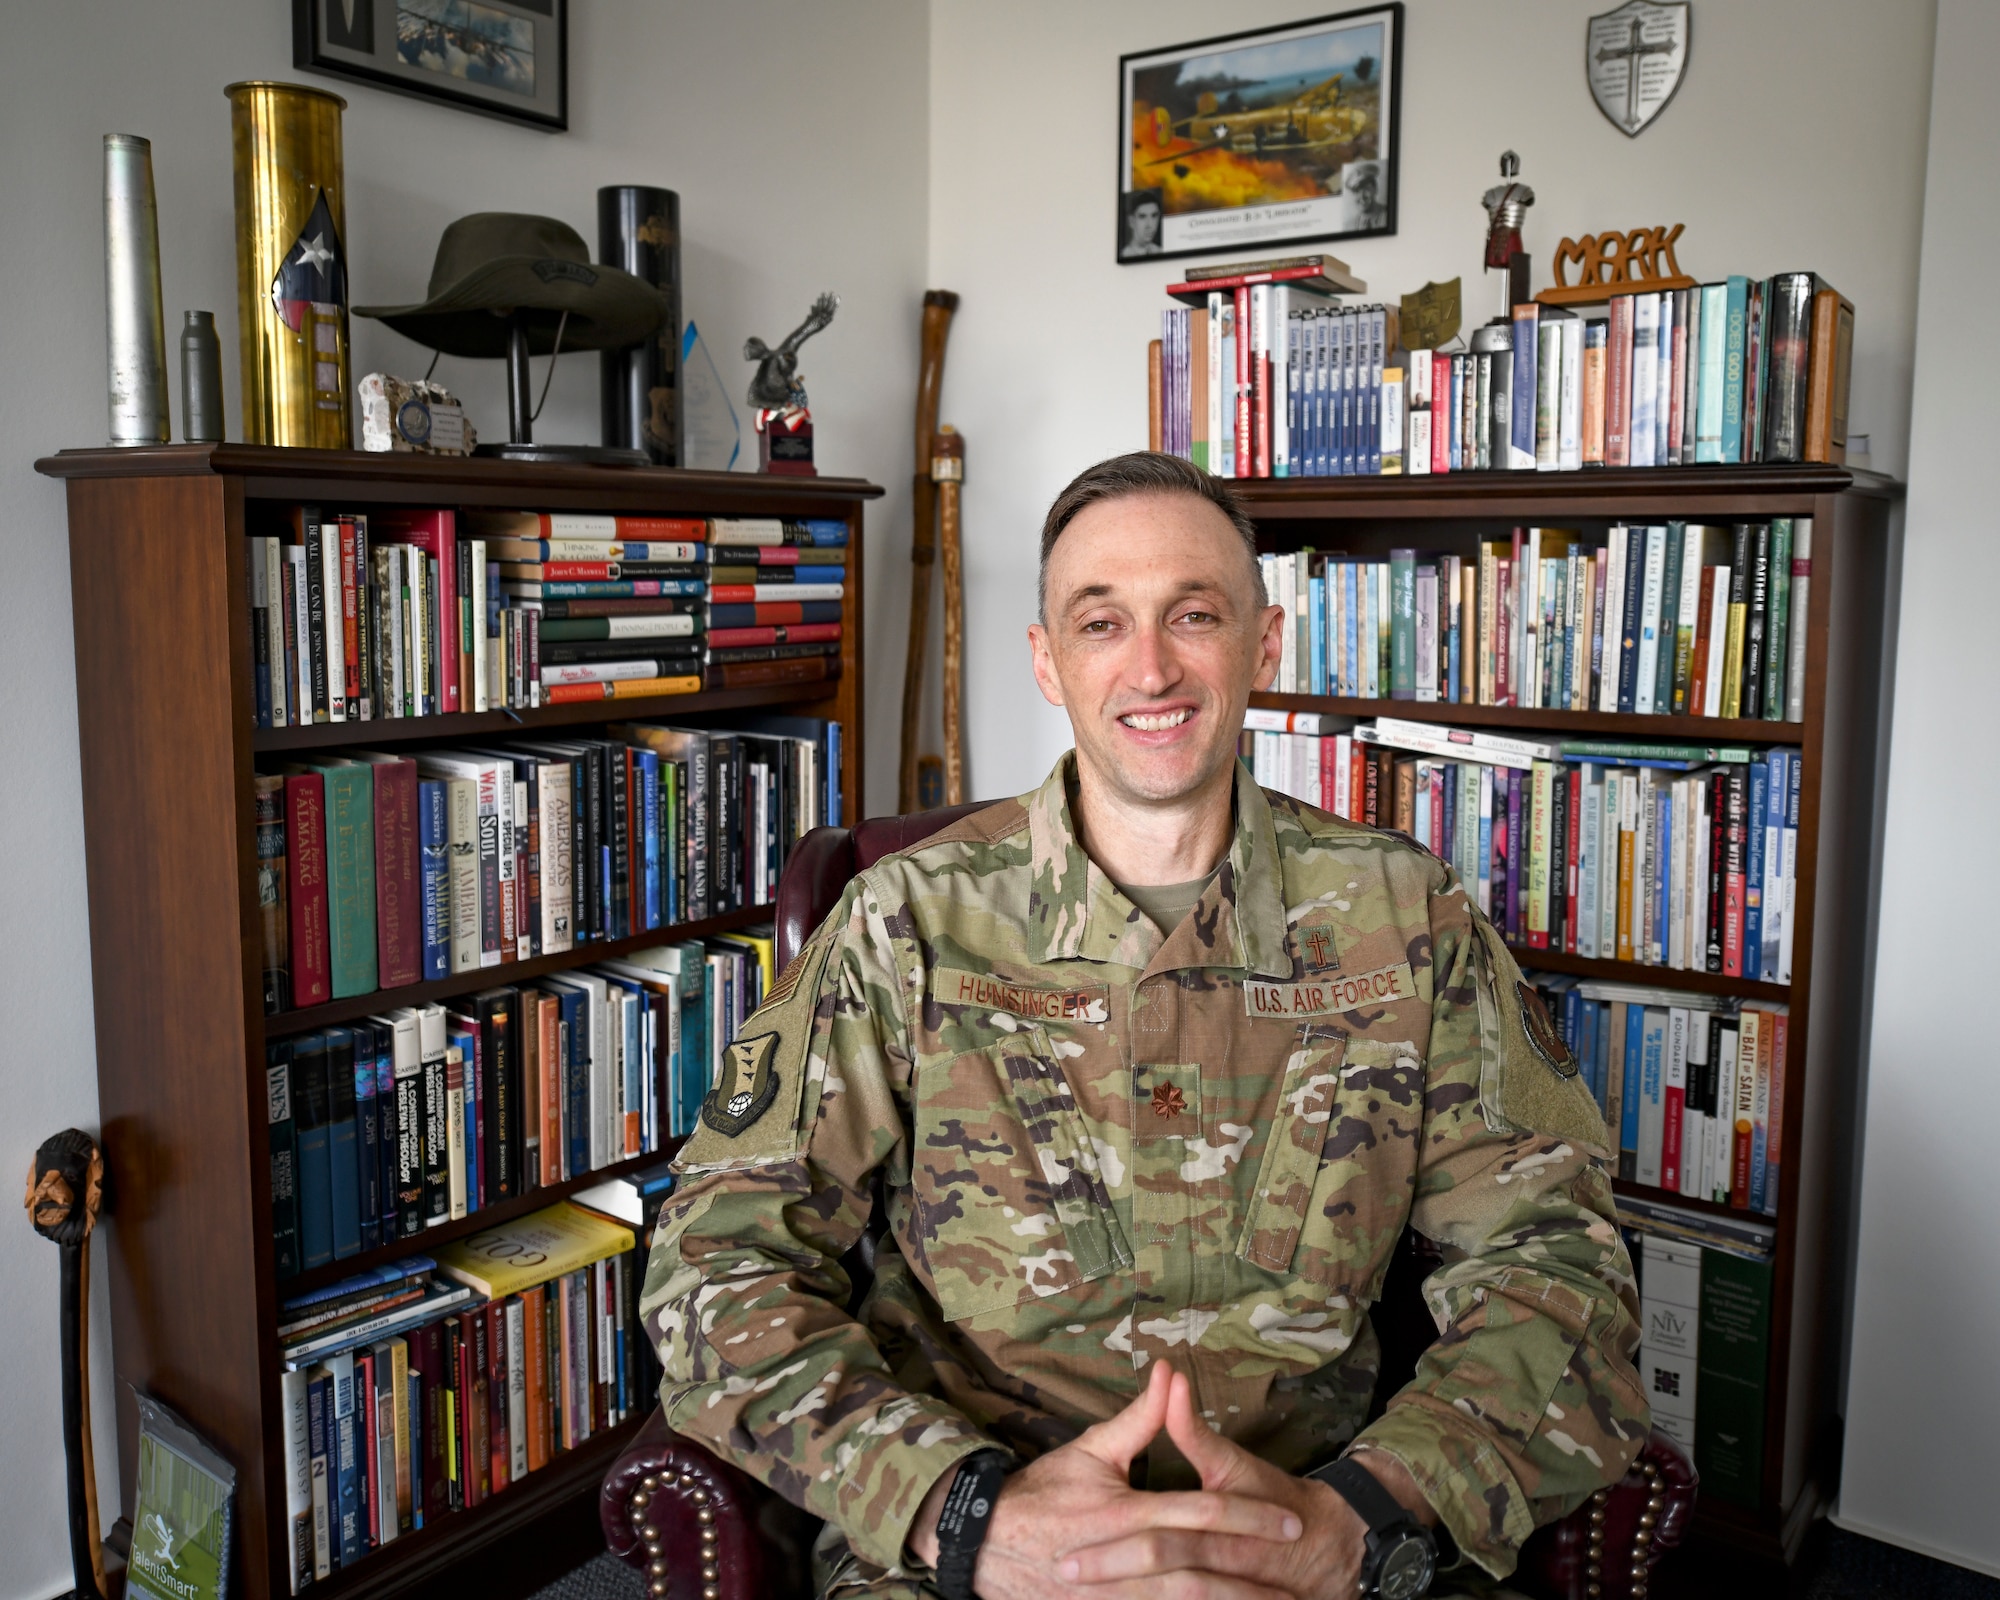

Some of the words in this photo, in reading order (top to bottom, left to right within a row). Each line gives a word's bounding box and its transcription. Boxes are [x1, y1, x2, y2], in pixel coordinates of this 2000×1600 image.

[1553, 224, 1685, 288] MARK
[1345, 324, 1354, 343] Every
[1360, 322, 1369, 342] Every
[1373, 321, 1384, 341] Every
[1729, 313, 1742, 349] DOES
[1434, 363, 1442, 401] preparing
[1728, 352, 1742, 381] GOD
[1726, 384, 1740, 425] EXIST?
[308, 525, 318, 538] BE
[344, 537, 355, 552] The
[564, 543, 599, 551] THINKING
[1686, 533, 1697, 557] YOU
[298, 560, 306, 570] BE
[309, 542, 319, 559] ALL
[356, 530, 364, 571] MAXWELL
[1650, 535, 1662, 575] FRESH
[310, 561, 319, 582] YOU
[344, 555, 356, 586] Winning
[551, 567, 567, 576] JOHN
[577, 567, 605, 575] MAXWELL
[1578, 563, 1586, 583] GOD'S
[298, 580, 308, 611] PEOPLE
[311, 584, 321, 608] CAN
[345, 589, 357, 618] Attitude
[358, 585, 366, 606] THINK
[1576, 588, 1585, 614] CHOSEN
[1595, 587, 1604, 609] BASIC
[1646, 579, 1659, 617] FAITH
[1680, 578, 1693, 618] MORE
[299, 613, 309, 645] PERSON
[312, 610, 322, 623] BE
[359, 611, 366, 621] ON
[312, 630, 322, 651] JOHN
[1592, 612, 1603, 670] CHRISTIANITY
[1623, 653, 1631, 688] CYMBALA
[1676, 633, 1688, 682] CYMBALA
[315, 663, 324, 700] MAXWELL
[1768, 672, 1777, 699] TOWNS
[1487, 739, 1526, 752] CHAPMAN
[1724, 752, 1746, 760] TRIPP
[614, 753, 624, 785] SEA
[695, 754, 705, 793] GOD'S
[1367, 761, 1377, 787] LOVE
[1510, 777, 1520, 791] THE
[1536, 770, 1545, 796] Have
[1730, 778, 1741, 790] IT
[381, 781, 392, 803] The
[480, 769, 495, 804] WAR
[502, 770, 511, 805] SECRETS
[615, 793, 625, 812] OF
[719, 763, 727, 828] Battlefields
[1366, 788, 1377, 813] MUST
[1554, 782, 1564, 802] Why
[1607, 779, 1617, 814] HEDGES
[433, 791, 441, 839] BENNETT
[457, 789, 466, 838] BENNETT
[1365, 813, 1376, 826] BE
[1510, 812, 1519, 831] LOVE
[1534, 808, 1544, 831] New
[1730, 793, 1740, 820] CAME
[480, 816, 497, 860] SOUL
[503, 821, 512, 857] SPECIAL
[695, 800, 706, 851] MIGHTY
[1554, 804, 1564, 846] Christian
[1730, 823, 1739, 841] FROM
[296, 798, 312, 886] ALMANAC
[382, 810, 396, 877] MORAL
[556, 798, 571, 887] AMERICA'S
[615, 822, 627, 874] GLORY
[1509, 831, 1518, 870] LANGUAGES
[1533, 834, 1543, 852] Kid
[1553, 848, 1563, 869] Kids
[503, 860, 513, 878] OPS
[696, 860, 706, 898] HAND
[720, 835, 728, 890] BLESSINGS
[1728, 844, 1739, 888] WITHIN!
[486, 866, 494, 907] EDWARD
[1553, 871, 1562, 896] Rebel
[460, 868, 475, 939] AMERICA
[503, 882, 514, 941] LEADERSHIP
[1532, 899, 1540, 929] Leman
[385, 881, 400, 964] COMPASS
[1604, 911, 1613, 939] JENKINS
[1727, 912, 1737, 951] STANLEY
[958, 975, 1090, 1018] HUNSINGER
[1255, 987, 1287, 1012] U.S.
[1293, 988, 1327, 1012] AIR
[1331, 970, 1401, 1008] FORCE
[1655, 1027, 1663, 1042] THE
[1745, 1022, 1754, 1034] THE
[1760, 1019, 1770, 1046] TOTAL
[1672, 1017, 1683, 1079] BOUNDARIES
[1741, 1036, 1755, 1062] BAIT
[408, 1080, 416, 1088] A
[435, 1064, 443, 1072] A
[464, 1060, 474, 1104] ROMANS
[1652, 1044, 1662, 1105] TRANSFORMATION
[1743, 1065, 1751, 1073] OF
[1757, 1050, 1769, 1114] FORGIVENESS
[269, 1066, 288, 1121] VINE'S
[398, 1080, 409, 1132] WESLEYAN
[425, 1065, 436, 1114] WESLEYAN
[1738, 1075, 1753, 1111] SATAN
[382, 1105, 394, 1141] JAMES
[435, 1073, 445, 1151] CONTEMPORARY
[364, 1114, 376, 1145] JOHN
[408, 1089, 419, 1169] CONTEMPORARY
[428, 1116, 437, 1166] THEOLOGY
[400, 1133, 410, 1183] THEOLOGY
[1739, 1139, 1748, 1159] JOHN
[1753, 1156, 1763, 1196] KENDALL
[496, 1319, 504, 1359] STROBEL
[1651, 1313, 1687, 1334] NIV
[476, 1329, 485, 1372] STROBEL
[338, 1376, 352, 1415] REFUTING
[294, 1400, 305, 1433] WHY
[340, 1416, 354, 1472] COMPROMISE
[293, 1440, 309, 1495] JESUS?
[313, 1460, 325, 1478] 2
[343, 1512, 355, 1541] Sarfati
[296, 1519, 306, 1570] ZACHARIAS
[132, 1542, 194, 1600] TalentSmart
